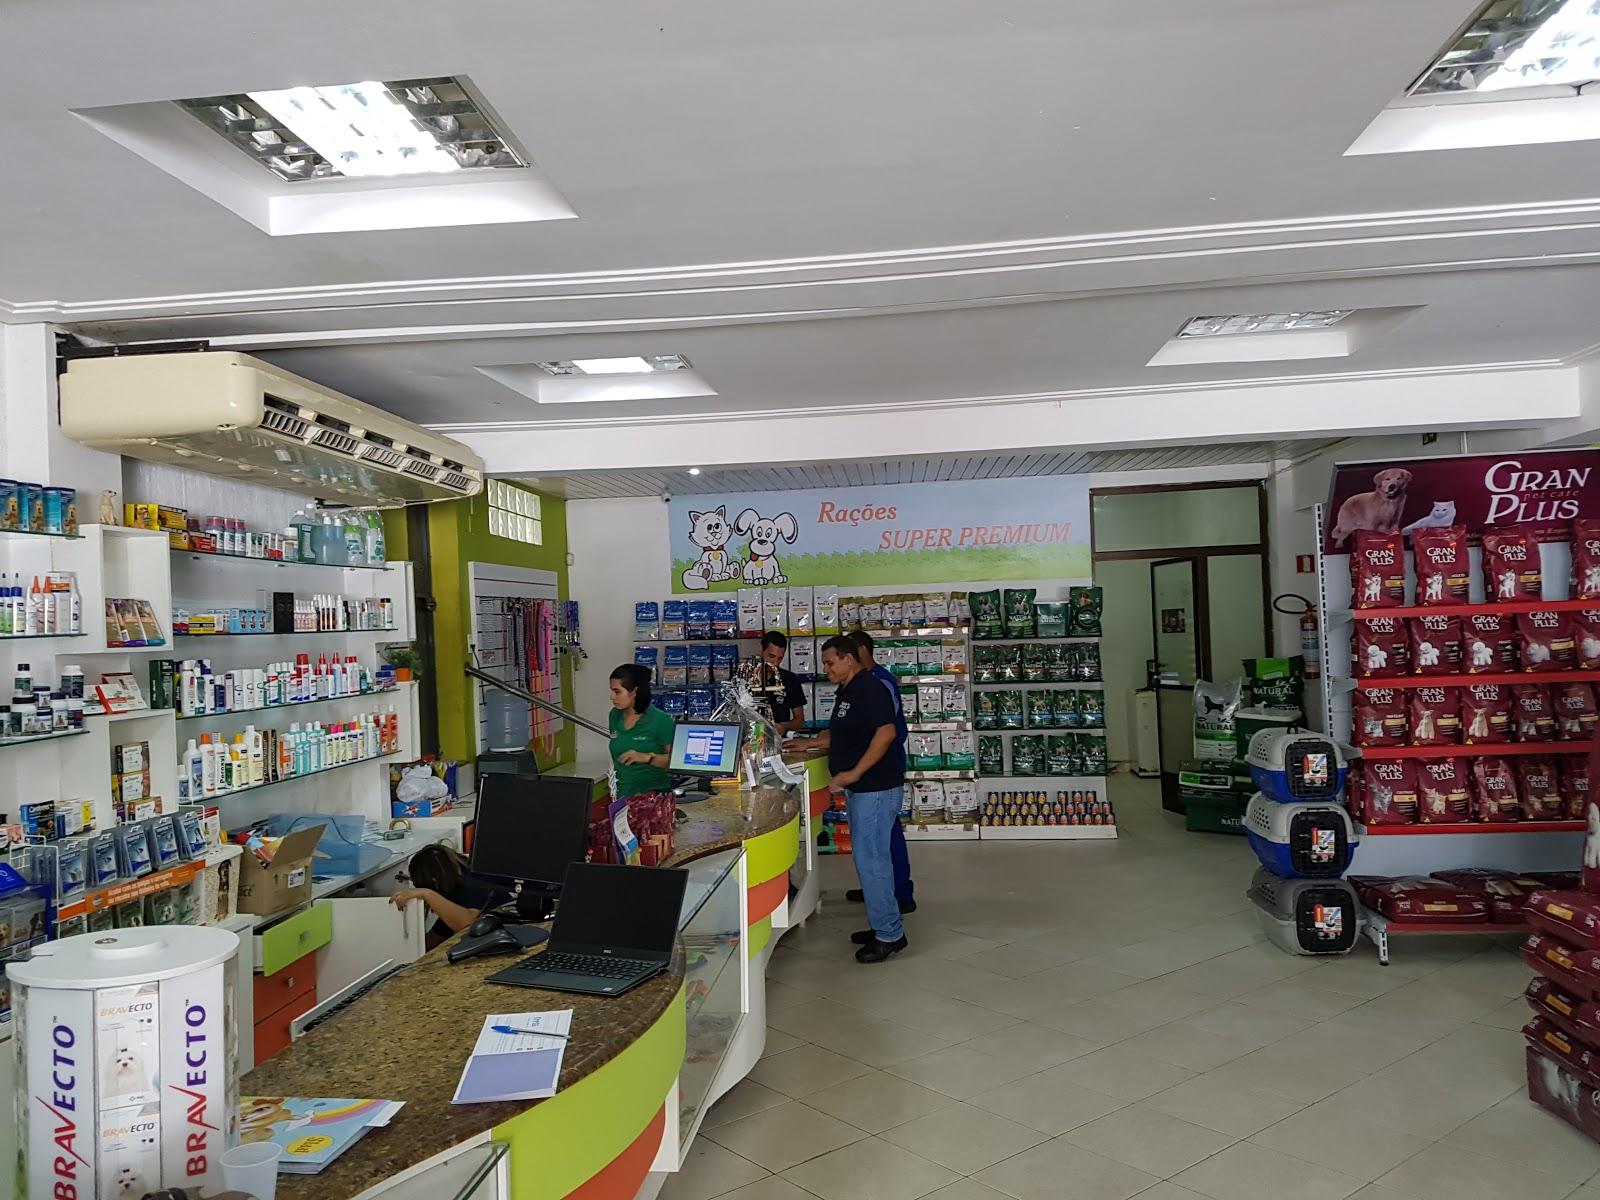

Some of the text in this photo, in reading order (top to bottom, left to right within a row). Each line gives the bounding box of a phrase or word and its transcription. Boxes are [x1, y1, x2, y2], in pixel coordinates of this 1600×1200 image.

[1484, 460, 1592, 493] GRAN
[1523, 490, 1580, 501] pet care
[816, 501, 898, 527] Rações
[1483, 493, 1580, 525] PLUS
[878, 521, 1072, 550] SUPER PREMIUM
[1365, 549, 1394, 558] GRAN
[1427, 546, 1456, 556] GRAN
[1497, 544, 1526, 554] GRAN
[1370, 556, 1394, 565] PLUS
[1431, 554, 1456, 564] PLUS
[1503, 552, 1526, 561] PLUS
[1472, 614, 1500, 624] GRAN
[1529, 612, 1558, 621] GRAN
[1476, 622, 1500, 631] PLUS
[1534, 619, 1558, 627] PLUS
[1365, 688, 1394, 698] GRAN
[1416, 687, 1445, 697] GRAN
[1470, 684, 1499, 694] GRAN
[1370, 695, 1393, 704] PLUS
[1422, 694, 1445, 703] PLUS
[1475, 691, 1498, 701] PLUS
[1374, 763, 1403, 773] GRAN
[1426, 763, 1454, 773] GRAN
[1379, 770, 1403, 780] PLUS
[1432, 770, 1455, 780] PLUS
[1221, 818, 1242, 826] NATU
[100, 1002, 153, 1017] BRAVECTO
[168, 1004, 220, 1177] BRAVECTO
[36, 1024, 91, 1200] BRAVECTO
[103, 1122, 155, 1138] BRAVECTO
